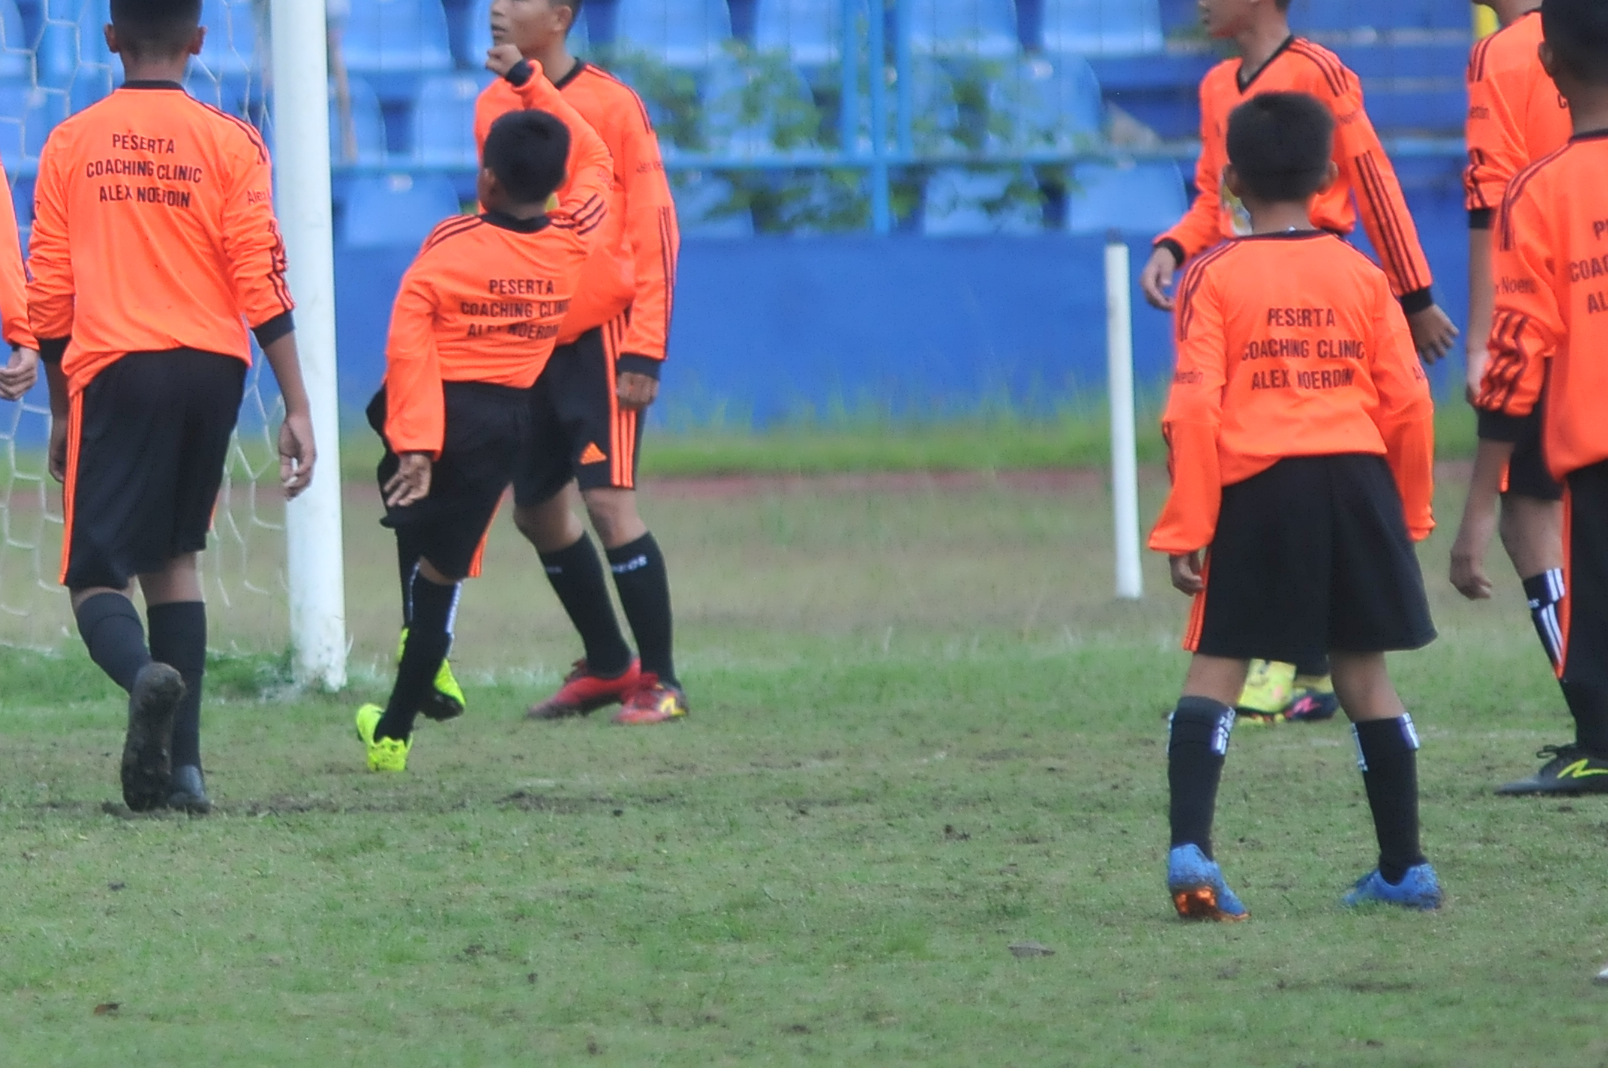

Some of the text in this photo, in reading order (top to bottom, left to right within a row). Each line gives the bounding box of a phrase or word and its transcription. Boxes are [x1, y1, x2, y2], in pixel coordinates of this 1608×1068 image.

[112, 133, 175, 154] PESERTA
[86, 158, 203, 184] COACHING CLINIC
[99, 184, 133, 203] ALEX
[488, 279, 554, 295] PESERTA
[460, 301, 533, 318] COACHING
[1267, 308, 1336, 327] PESERTA
[1242, 338, 1365, 361] COACHING CLINIC
[1251, 369, 1291, 391] ALEX
